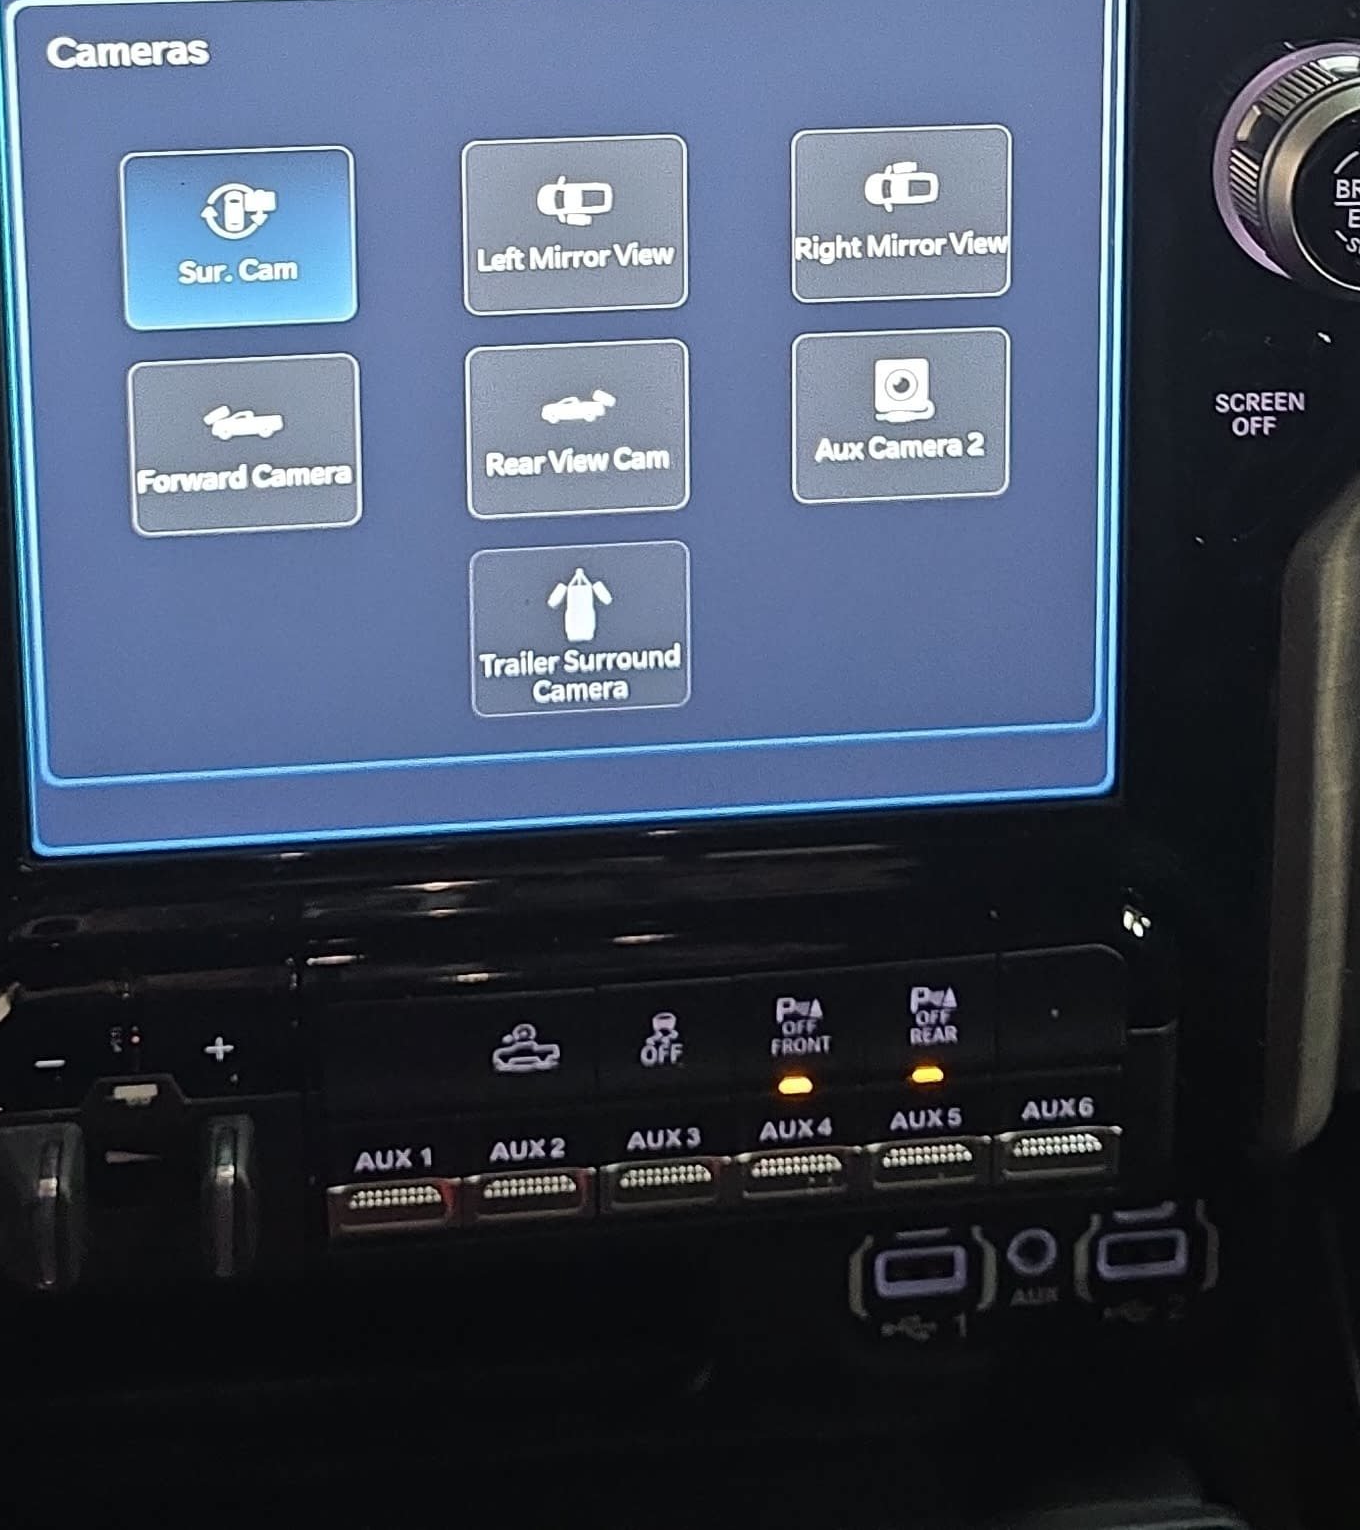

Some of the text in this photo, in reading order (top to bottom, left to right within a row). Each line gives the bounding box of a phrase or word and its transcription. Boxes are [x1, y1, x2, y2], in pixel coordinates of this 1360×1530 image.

[46, 36, 211, 69] Cameras
[476, 241, 675, 273] Left Mirror View
[794, 229, 1009, 266] Right Mirror View
[178, 257, 299, 285] Sur. Cam
[1215, 392, 1305, 413] SCREEN
[1231, 416, 1277, 437] OFF
[814, 432, 986, 463] Aux Camera 2
[485, 446, 671, 477] Rear View Cam
[138, 462, 353, 494] Forward Camera
[479, 643, 682, 678] Trailer Surround
[532, 677, 630, 704] Camera
[782, 1019, 817, 1037] OFF
[916, 1009, 951, 1026] OFF
[771, 1035, 832, 1055] FRONT
[910, 1025, 959, 1046] REAR
[640, 1043, 684, 1066] OFF
[890, 1106, 963, 1133] AUX 5
[1022, 1096, 1095, 1121] AUX 6
[626, 1126, 702, 1151] AUX 3
[759, 1116, 833, 1142] AUX 4
[355, 1146, 433, 1172] AUX 1
[489, 1137, 566, 1163] AUX 2
